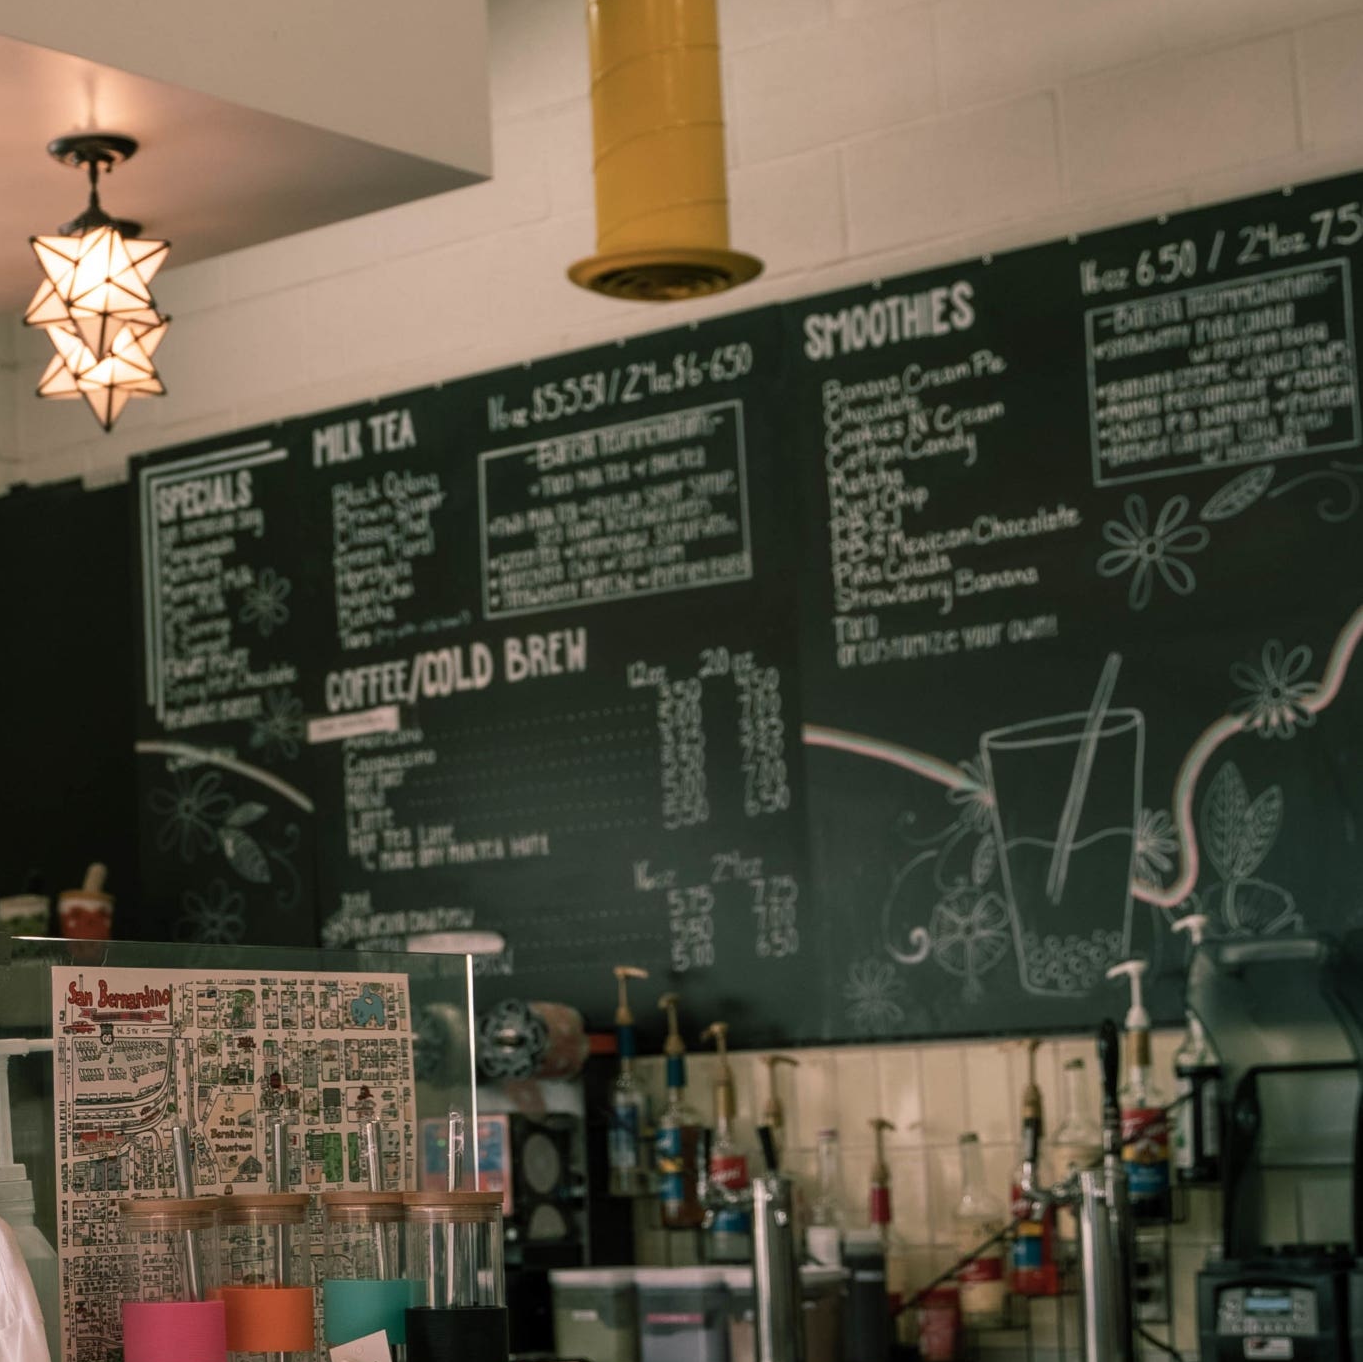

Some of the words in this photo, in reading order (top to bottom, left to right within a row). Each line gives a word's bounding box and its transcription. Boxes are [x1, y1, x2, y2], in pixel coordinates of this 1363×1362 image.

[803, 280, 975, 361] SMOOTHIES
[902, 363, 971, 394] Cream
[823, 394, 921, 429] Chocolate
[934, 401, 1005, 433] Cream
[312, 417, 363, 468] MILK
[367, 409, 416, 454] TEA
[825, 440, 903, 473] Cotton
[903, 433, 978, 467] Candy
[157, 468, 253, 524] SPECIALS
[880, 486, 929, 513] Chip
[971, 504, 1082, 545] Chocolate
[834, 580, 953, 615] Strawberry
[954, 566, 1039, 596] Banana
[325, 641, 494, 713] COFFEE/COLD
[503, 626, 587, 683] BREW
[68, 981, 93, 1007] San
[98, 979, 172, 1009] Bernardino
[210, 1128, 254, 1140] Bernardino
[219, 1114, 235, 1127] San
[215, 1143, 252, 1153] Downtown
[96, 1191, 110, 1199] 2ND
[96, 1246, 118, 1254] RIALTO
